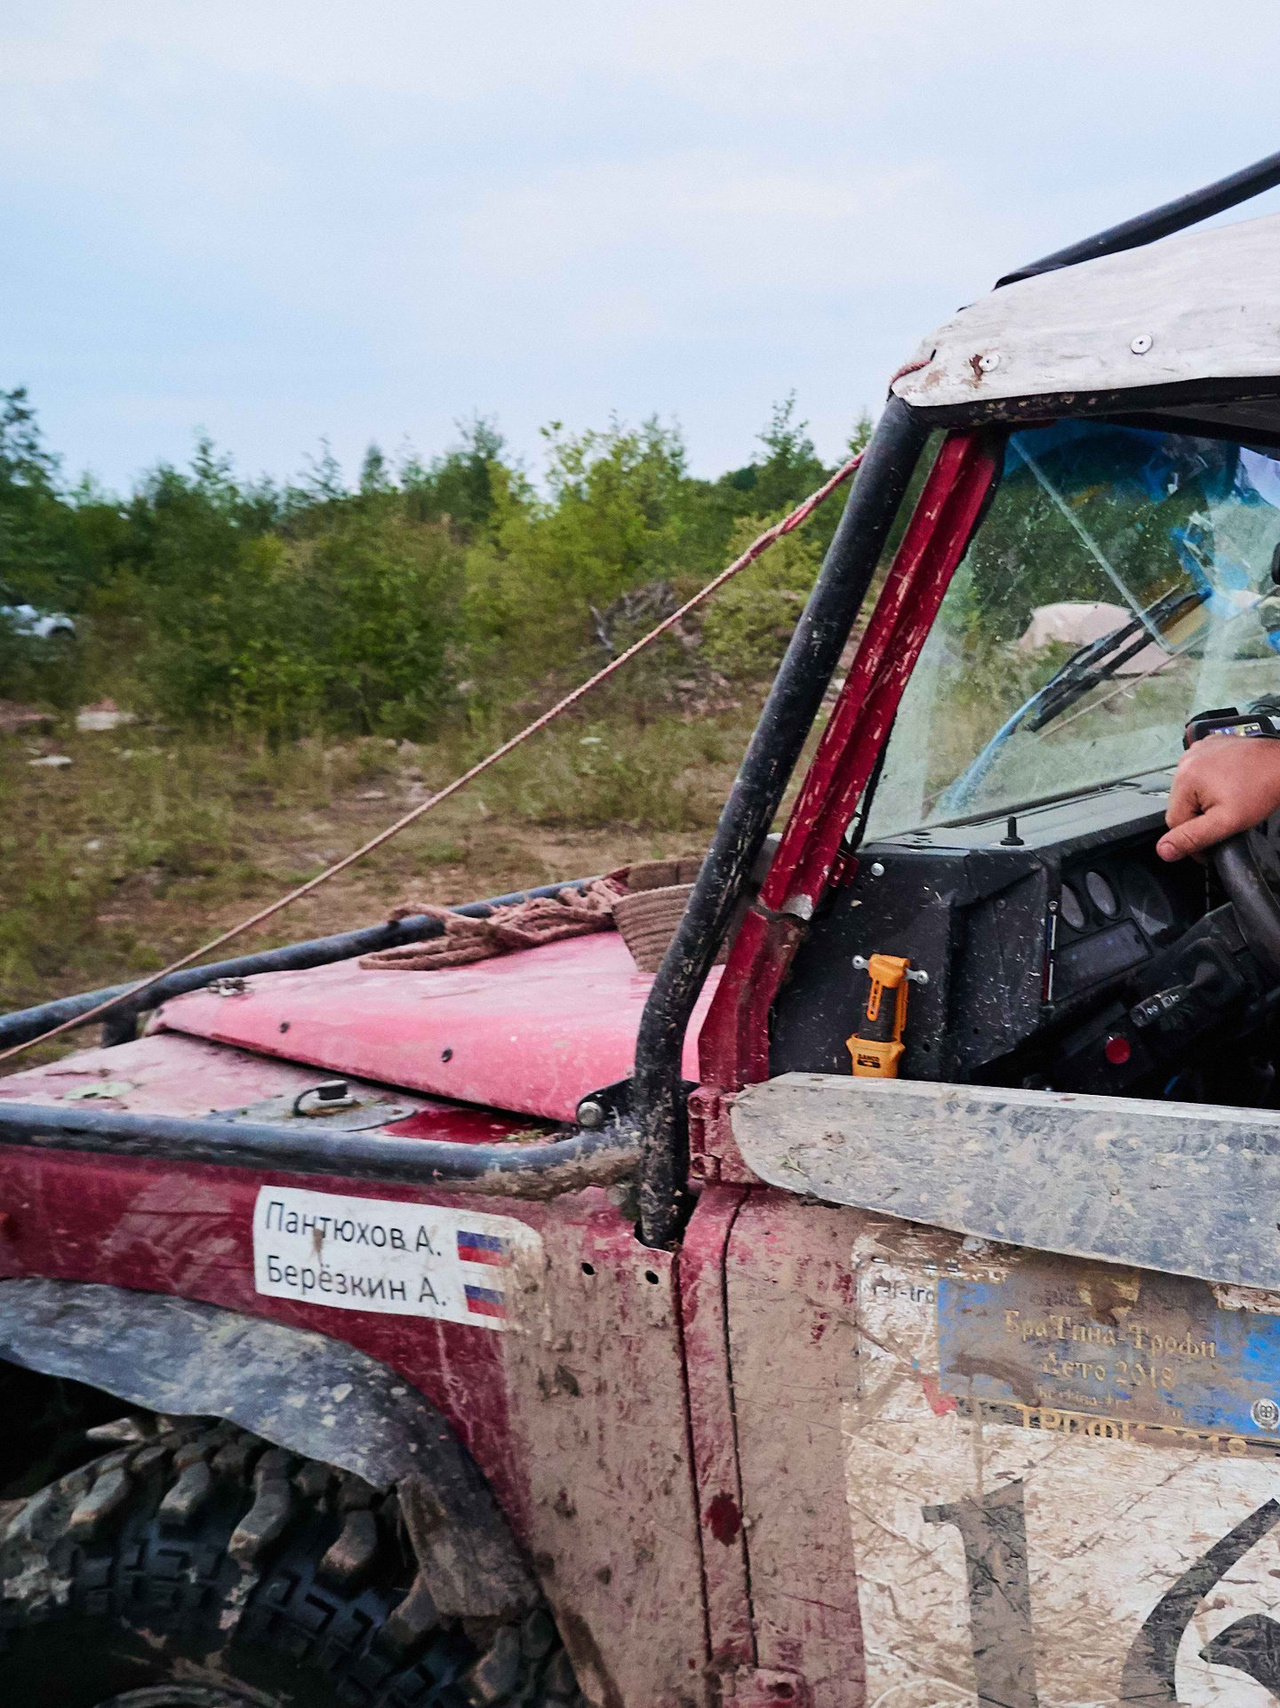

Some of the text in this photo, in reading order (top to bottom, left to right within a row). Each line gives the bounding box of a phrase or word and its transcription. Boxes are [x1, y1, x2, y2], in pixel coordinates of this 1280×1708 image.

[265, 1202, 442, 1256] Пантюхов А.
[267, 1255, 447, 1306] Берёзкин А.
[1115, 1360, 1176, 1391] 2018
